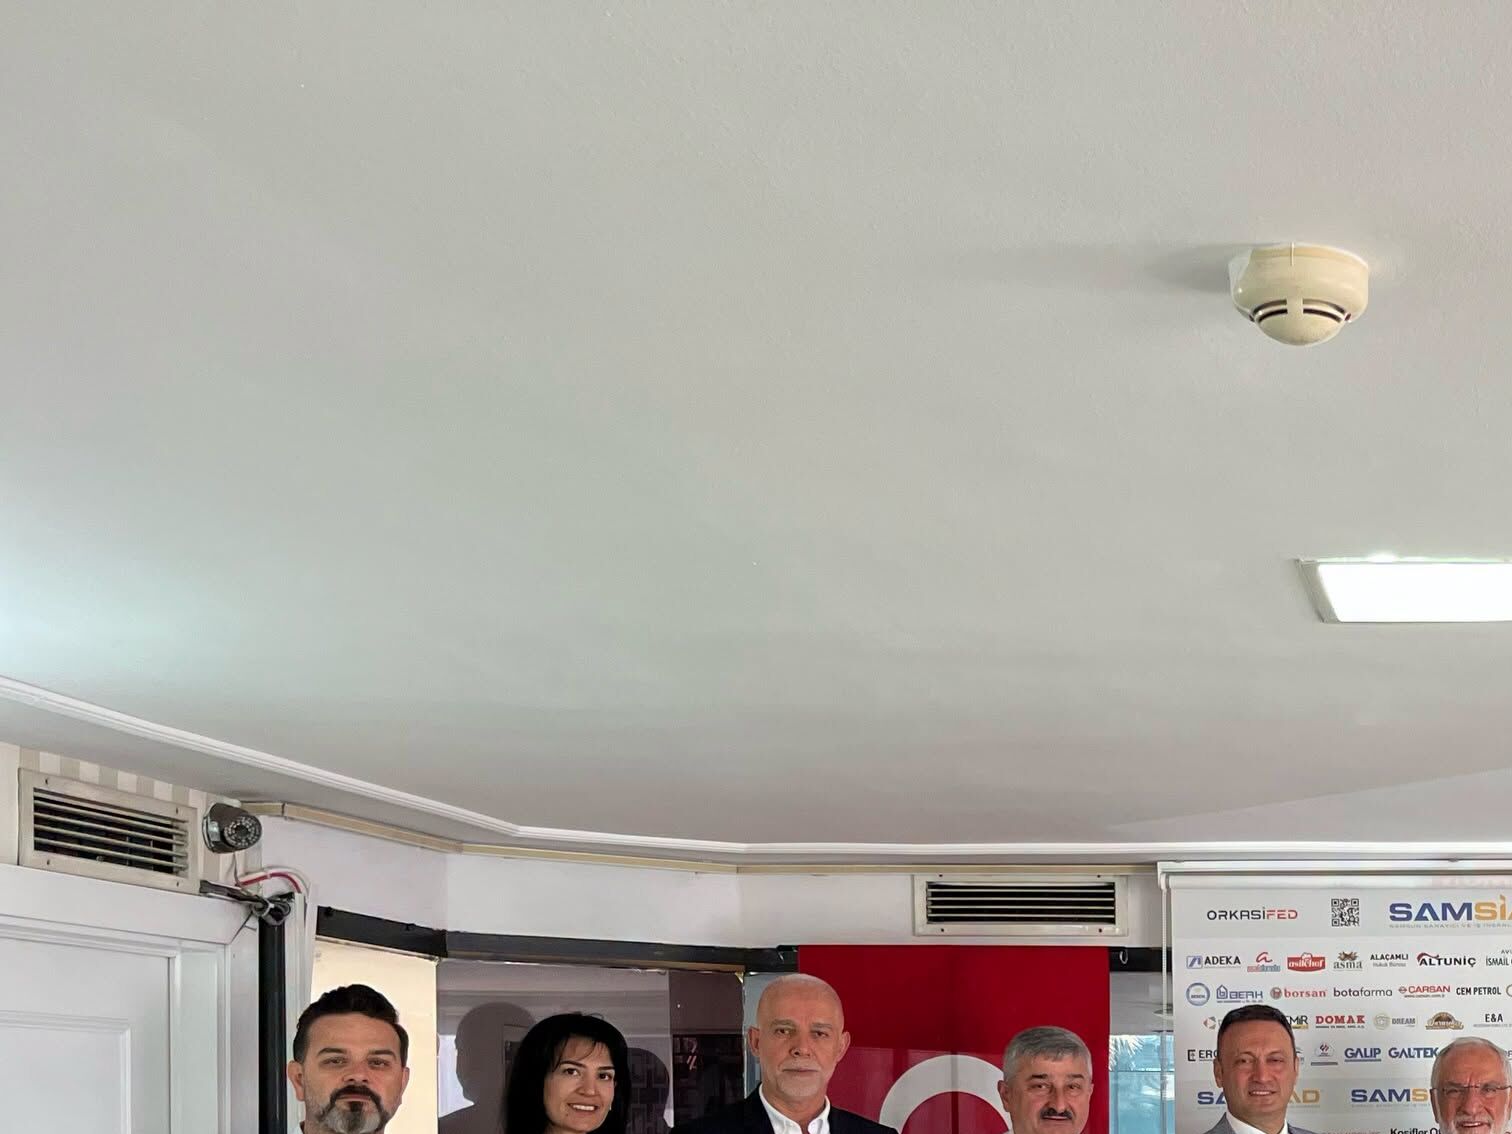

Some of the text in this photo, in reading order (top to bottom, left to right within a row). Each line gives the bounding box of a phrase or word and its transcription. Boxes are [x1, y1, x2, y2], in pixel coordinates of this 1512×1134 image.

[1205, 956, 1241, 965] ADEKA
[1333, 960, 1362, 969] asma
[1419, 955, 1476, 967] ALTUNİÇ
[1284, 988, 1326, 998] borsan
[1334, 988, 1392, 997] botafarma
[1408, 985, 1451, 994] CARSAN
[1456, 987, 1501, 995] CEM PETROL
[1316, 1015, 1365, 1024] DOMAK
[1485, 1013, 1503, 1023] E&A
[1389, 1047, 1438, 1059] GALTEK
